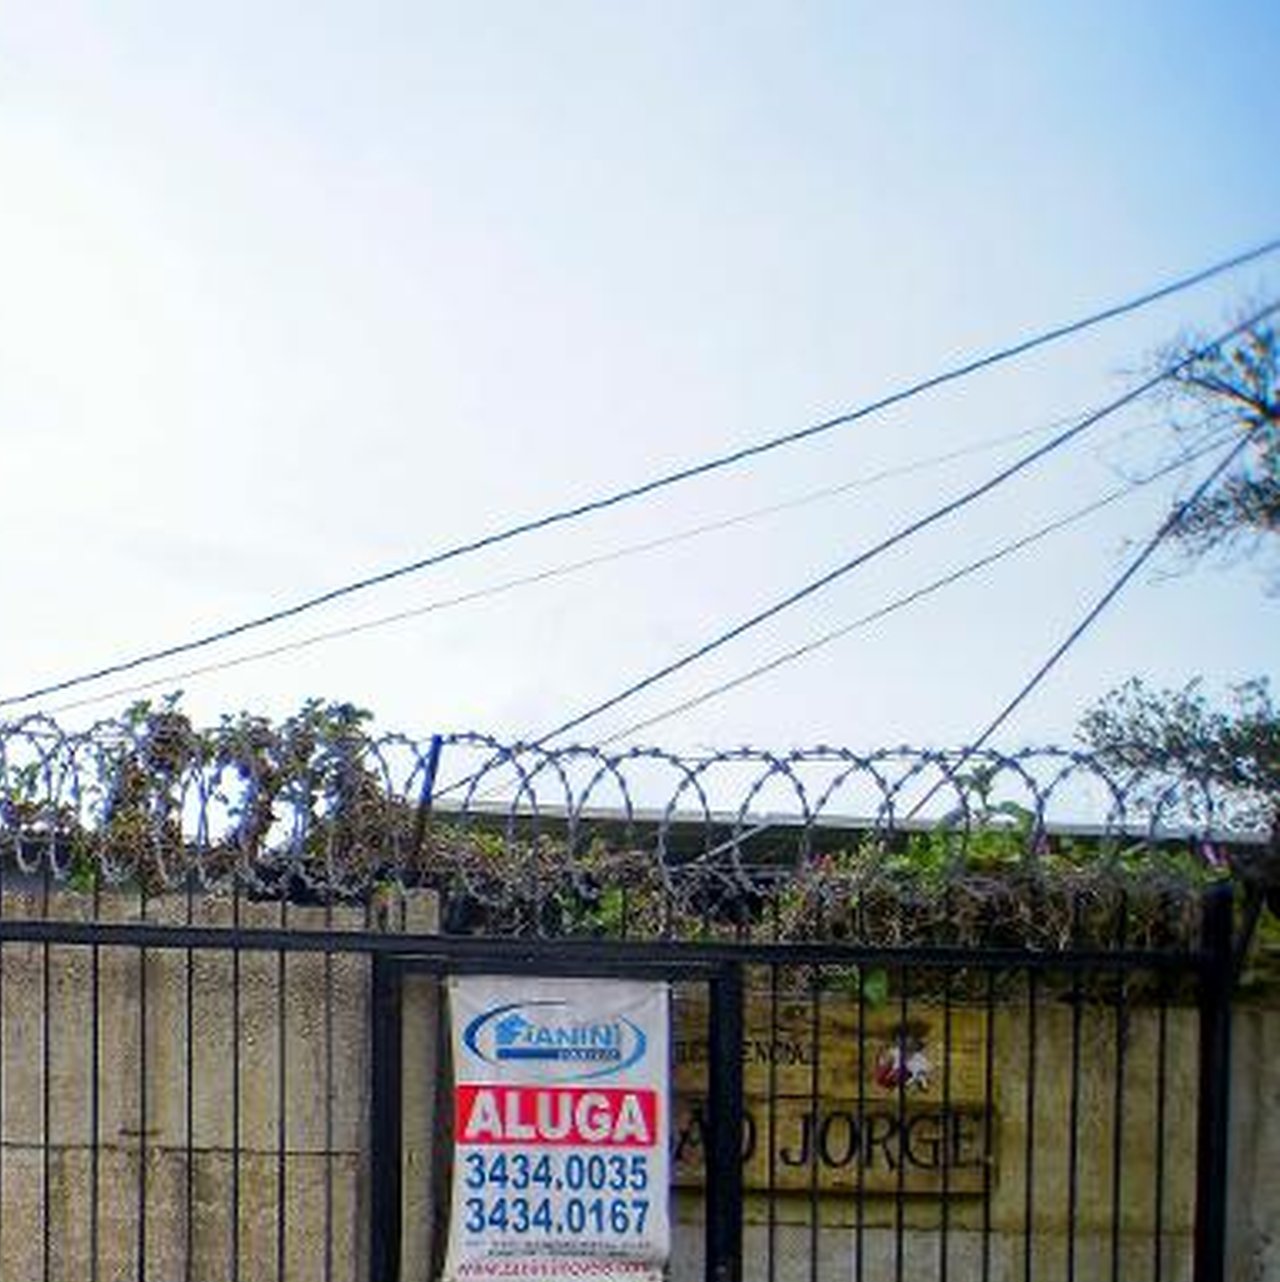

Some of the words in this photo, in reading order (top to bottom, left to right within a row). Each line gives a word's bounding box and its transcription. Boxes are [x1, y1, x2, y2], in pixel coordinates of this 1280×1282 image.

[465, 1090, 649, 1142] ALUGA
[780, 1110, 991, 1172] JORGE
[465, 1153, 648, 1192] 3434.0035
[465, 1197, 651, 1235] 3434.0167
